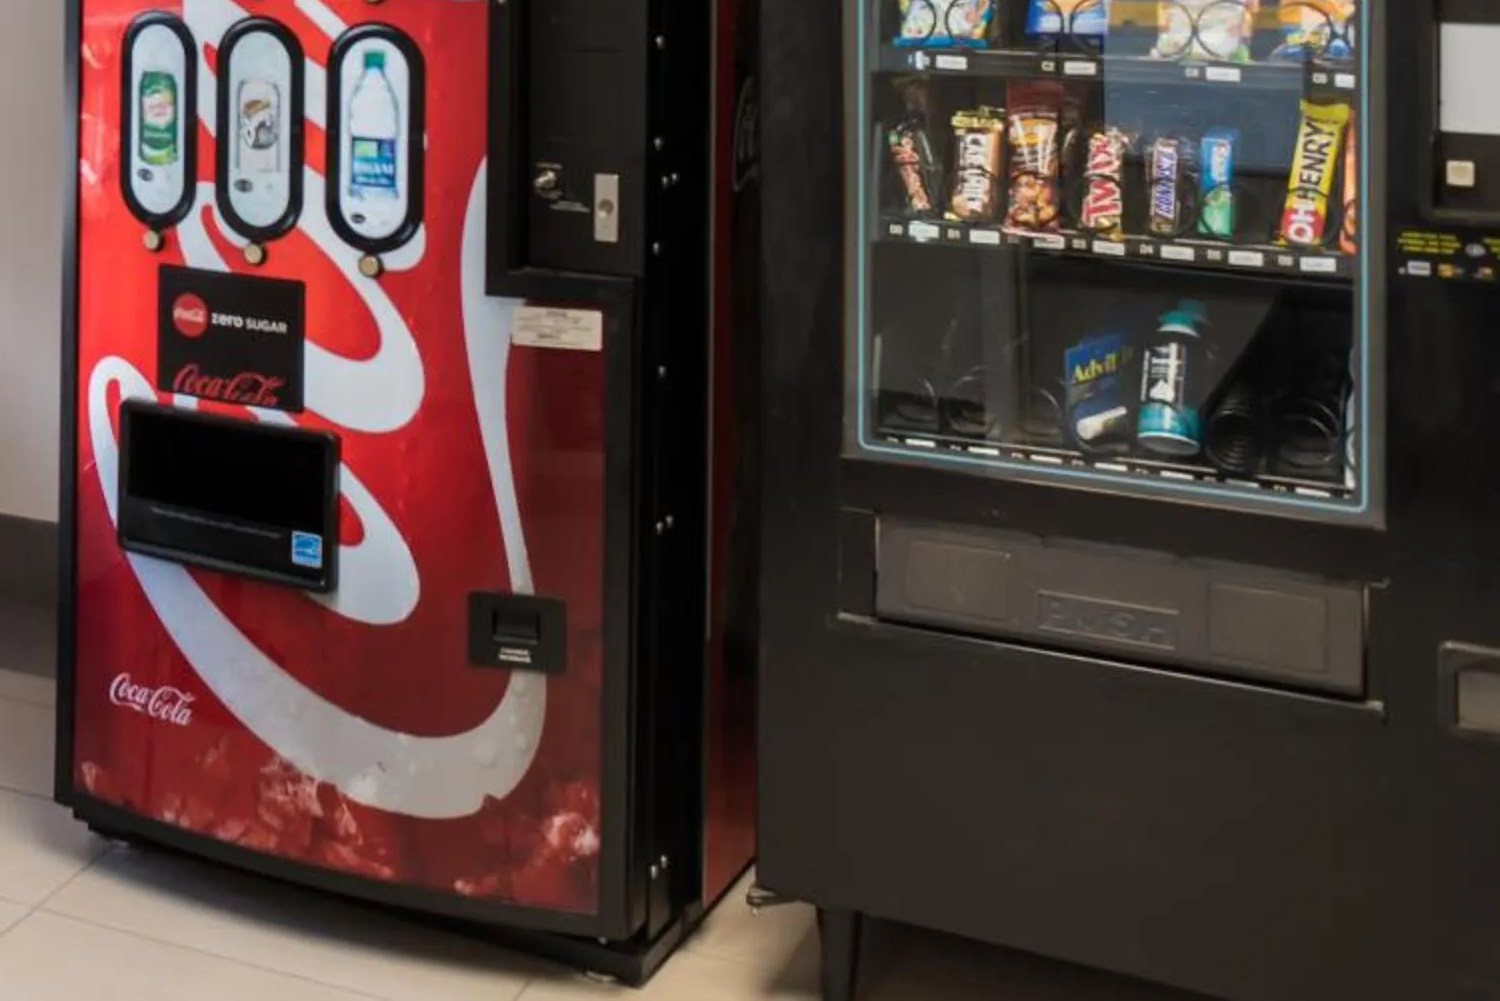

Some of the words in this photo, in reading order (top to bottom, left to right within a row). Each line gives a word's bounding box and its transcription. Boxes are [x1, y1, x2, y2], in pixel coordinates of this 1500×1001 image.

[1287, 206, 1316, 243] OH
[246, 316, 288, 335] SUGAR
[1074, 352, 1118, 384] Advil
[108, 672, 197, 727] Coca-Cola
